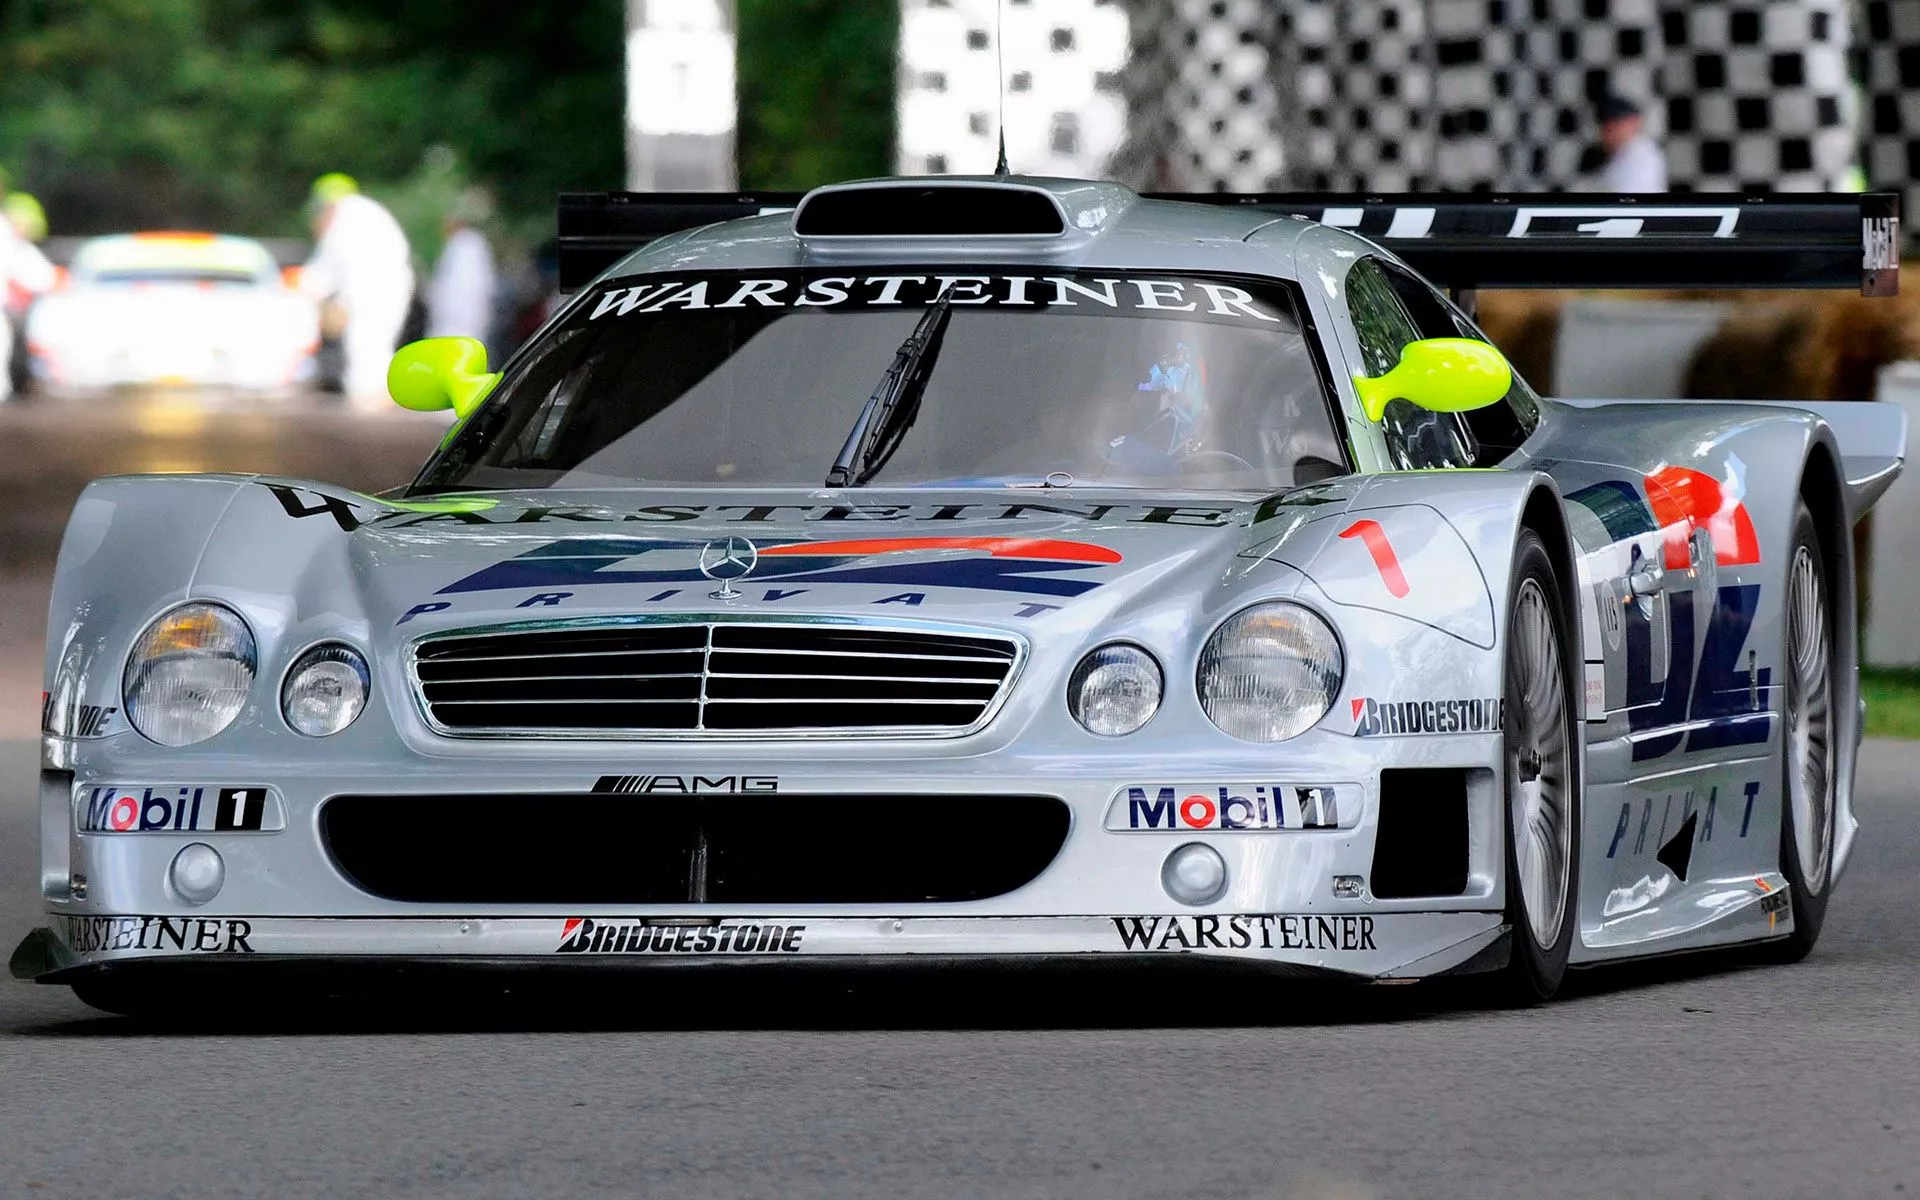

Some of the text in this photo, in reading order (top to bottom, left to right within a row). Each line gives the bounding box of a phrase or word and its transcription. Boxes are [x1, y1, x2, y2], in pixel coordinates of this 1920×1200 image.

[590, 275, 1280, 323] WARSTEINER
[1338, 518, 1410, 599] 1
[396, 588, 1065, 626] PRIVAT
[646, 775, 779, 794] AMG
[86, 787, 204, 832] Mobil
[1127, 786, 1286, 829] Mobil
[68, 916, 256, 955] WARSTEINER
[556, 917, 807, 953] BRIDGESTONE
[1112, 915, 1377, 951] WARSTEINER
